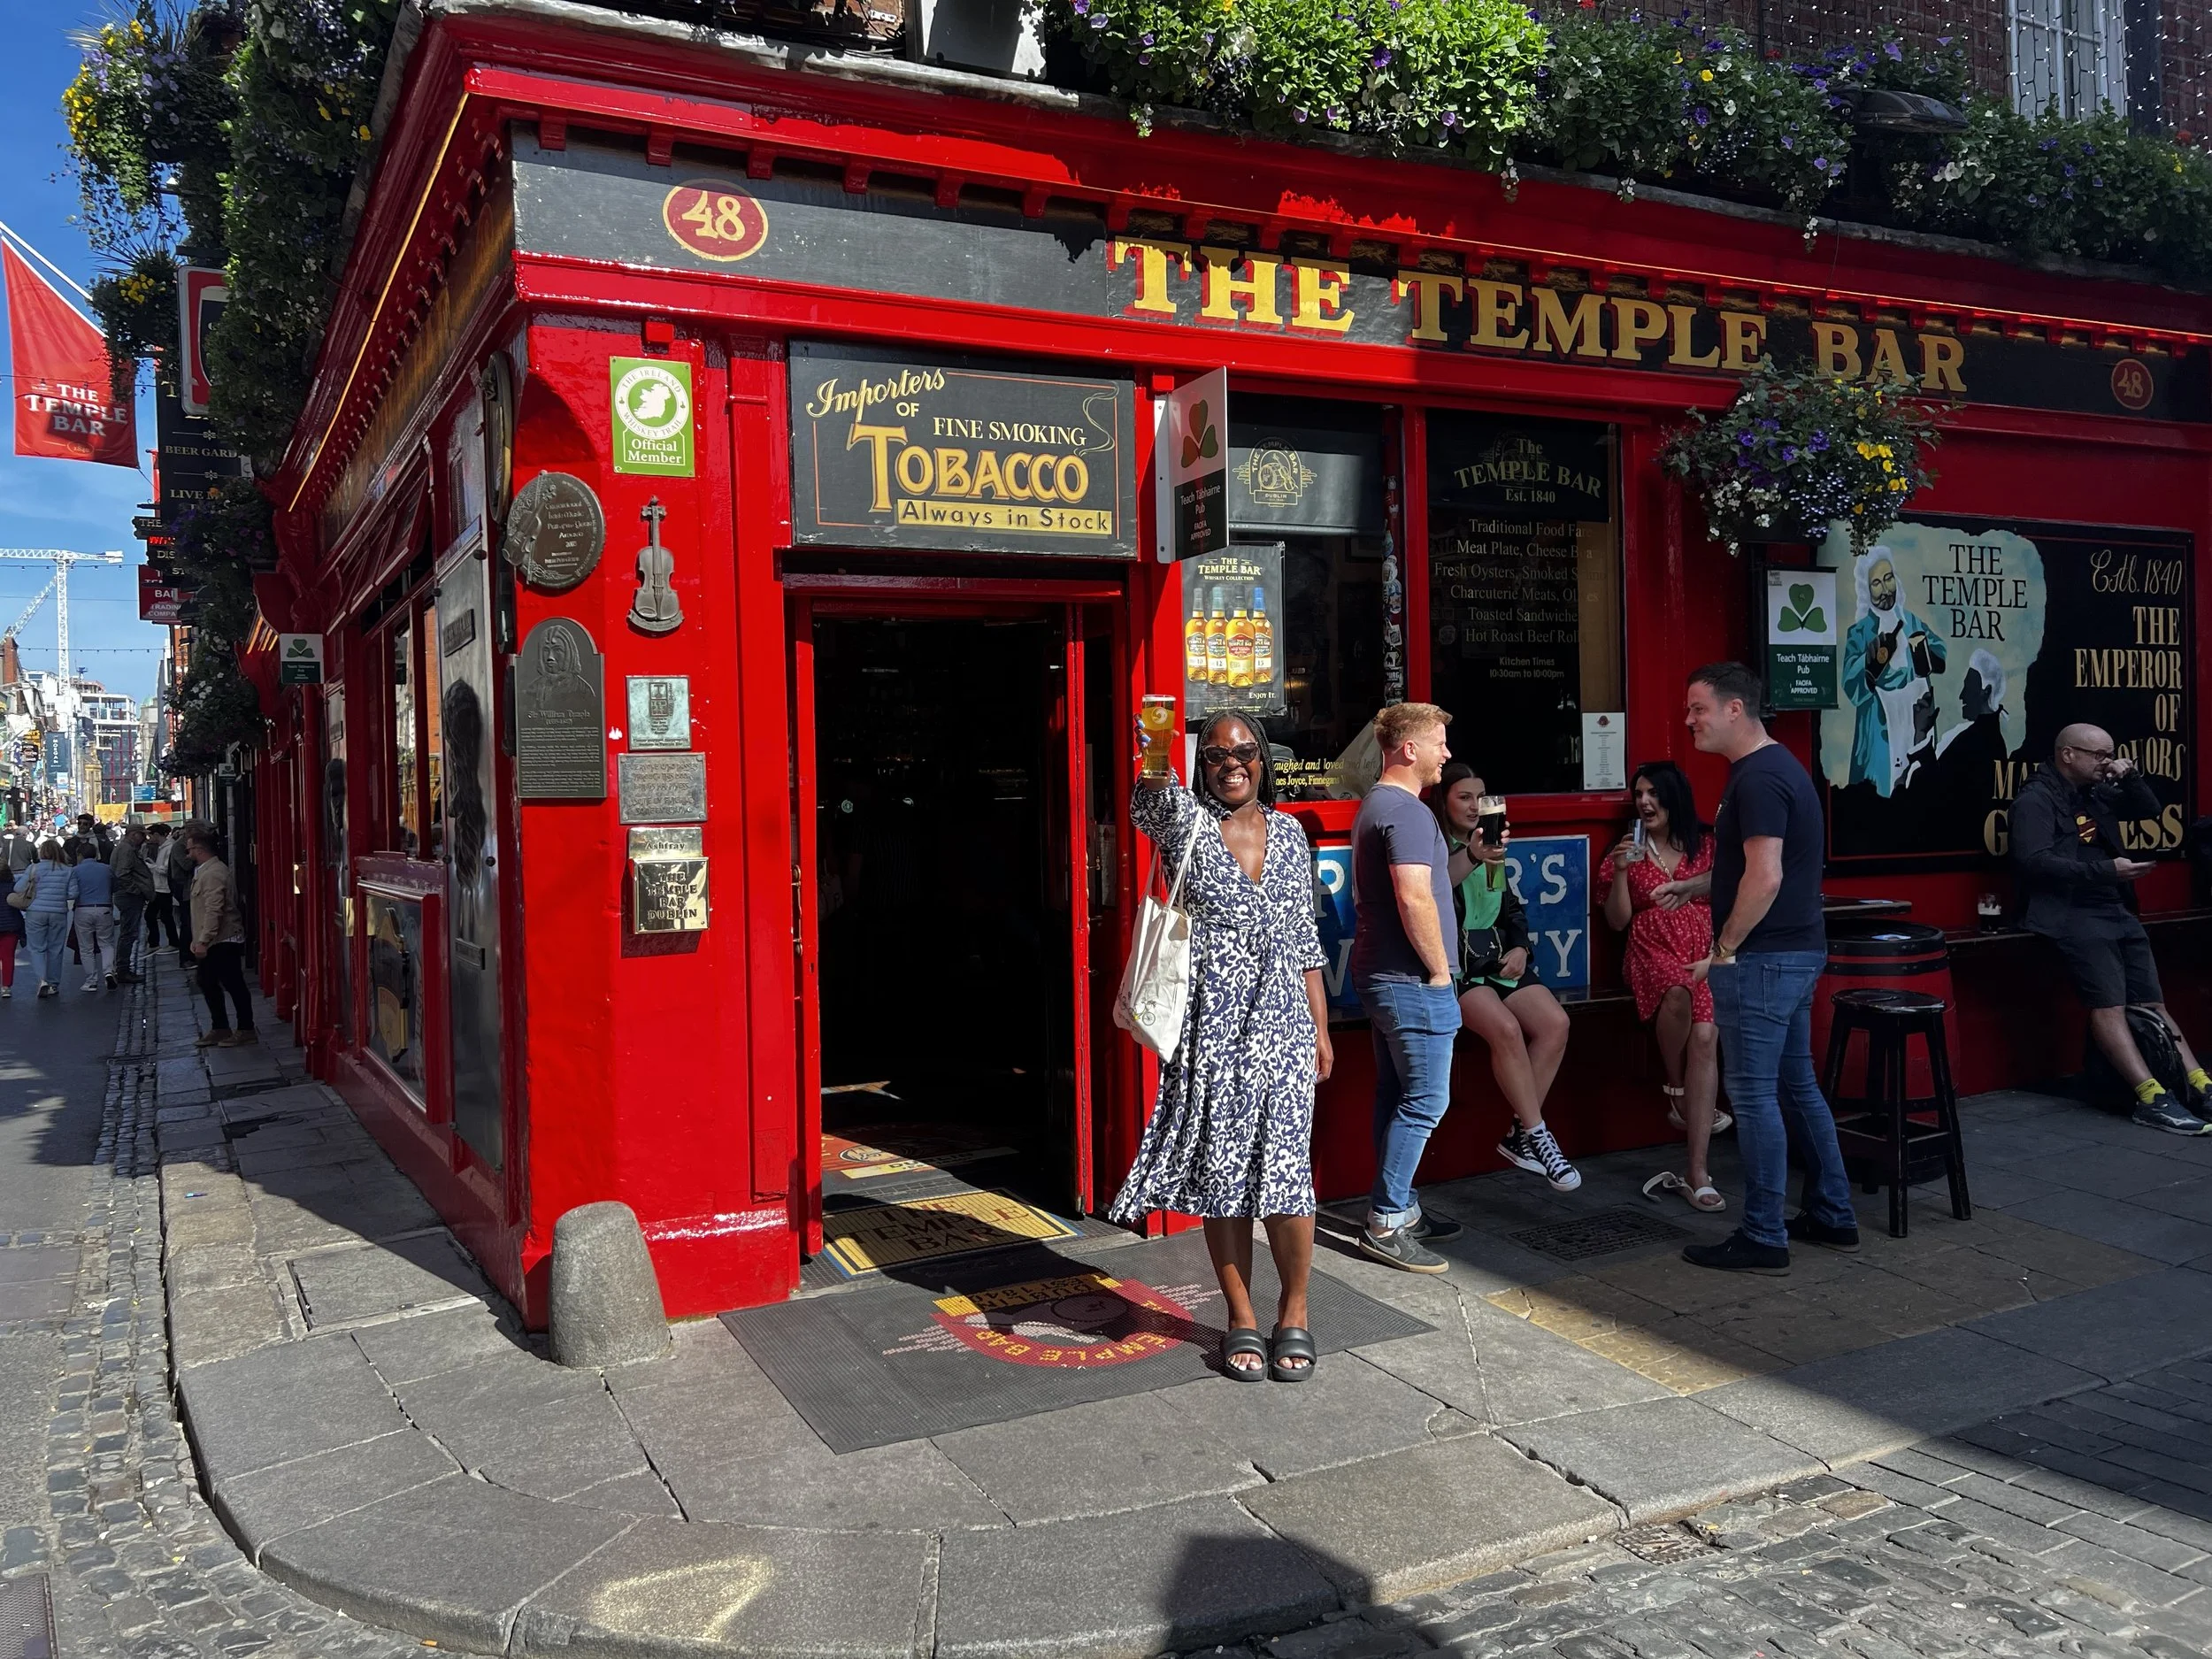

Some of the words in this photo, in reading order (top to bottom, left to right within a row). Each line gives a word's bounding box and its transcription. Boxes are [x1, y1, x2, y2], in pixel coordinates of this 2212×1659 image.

[680, 189, 748, 242] 48
[1110, 236, 1356, 337] THE
[1394, 269, 1769, 372] TEMPLE
[1810, 319, 1967, 393] BAR
[641, 369, 681, 393] IRELAND
[2117, 367, 2144, 399] 48
[56, 383, 99, 403] THE
[804, 367, 945, 423] Importers
[24, 395, 127, 425] TEMPLE
[895, 400, 920, 418] OF
[52, 415, 107, 436] BAR
[623, 411, 658, 437] WHISKEY
[661, 419, 682, 436] TRAIL
[932, 416, 984, 440] FINE
[988, 420, 1087, 447] SMOKING
[165, 445, 200, 456] BEER
[201, 448, 238, 458] GARD
[631, 438, 678, 452] Official
[1517, 438, 1544, 455] The
[627, 449, 682, 464] Member
[845, 421, 1090, 513] TOBACCO
[1454, 460, 1550, 489] TEMPLE
[1556, 465, 1601, 499] BAR
[169, 488, 204, 500] LIVE
[1180, 492, 1195, 506] Teach
[1505, 488, 1527, 503] Est.
[1530, 488, 1555, 503] 1840
[901, 498, 994, 526] Always
[1007, 508, 1029, 526] in
[1039, 507, 1109, 532] Stock
[1194, 502, 1206, 515] Pub
[139, 518, 163, 527] THE
[1469, 518, 1532, 536] Traditional
[1536, 521, 1565, 536] Food
[1456, 540, 1487, 555] Meat
[1491, 541, 1524, 558] Plate,
[1526, 542, 1567, 558] Cheese
[1947, 543, 2004, 575] THE
[1197, 565, 1239, 574] TEMPLE
[1240, 565, 1262, 575] BAR
[1433, 562, 1467, 577] Fresh
[1522, 565, 1568, 580] Smoked
[2144, 559, 2183, 595] 1840
[1449, 584, 1519, 601] Charcuterie
[1521, 587, 1558, 603] Meats,
[1922, 575, 2029, 610] TEMPLE
[1468, 606, 1514, 621] Toasted
[1516, 608, 1578, 623] Sandwiche
[1949, 608, 2006, 641] BAR
[2132, 606, 2180, 646] THE
[1465, 628, 1487, 643] Hot
[1491, 629, 1524, 643] Roast
[1527, 629, 1556, 643] Beef
[1499, 657, 1531, 666] Kitchen
[1532, 657, 1555, 666] Times
[1776, 653, 1796, 663] Teach
[1797, 653, 1830, 664] Tábhairne
[1523, 669, 1532, 678] to
[1796, 664, 1810, 675] Pub
[2074, 648, 2183, 690] EMPEROR
[2154, 694, 2181, 733] OF
[1274, 758, 1304, 774] aughed
[1304, 758, 1321, 772] and
[1323, 757, 1345, 771] loved
[2117, 737, 2186, 782] QUORS
[1287, 774, 1308, 787] Joyce,
[1983, 803, 2185, 856] GESS
[645, 841, 686, 850] Ashtray
[658, 872, 686, 883] THE
[647, 884, 698, 896] TEMPLE
[659, 896, 686, 908] BAR
[647, 909, 698, 920] DUBLIN
[868, 1199, 961, 1222] THE
[835, 1204, 1030, 1246] TEMPLE
[905, 1227, 1008, 1251] BAR
[975, 1328, 1031, 1357] BAR
